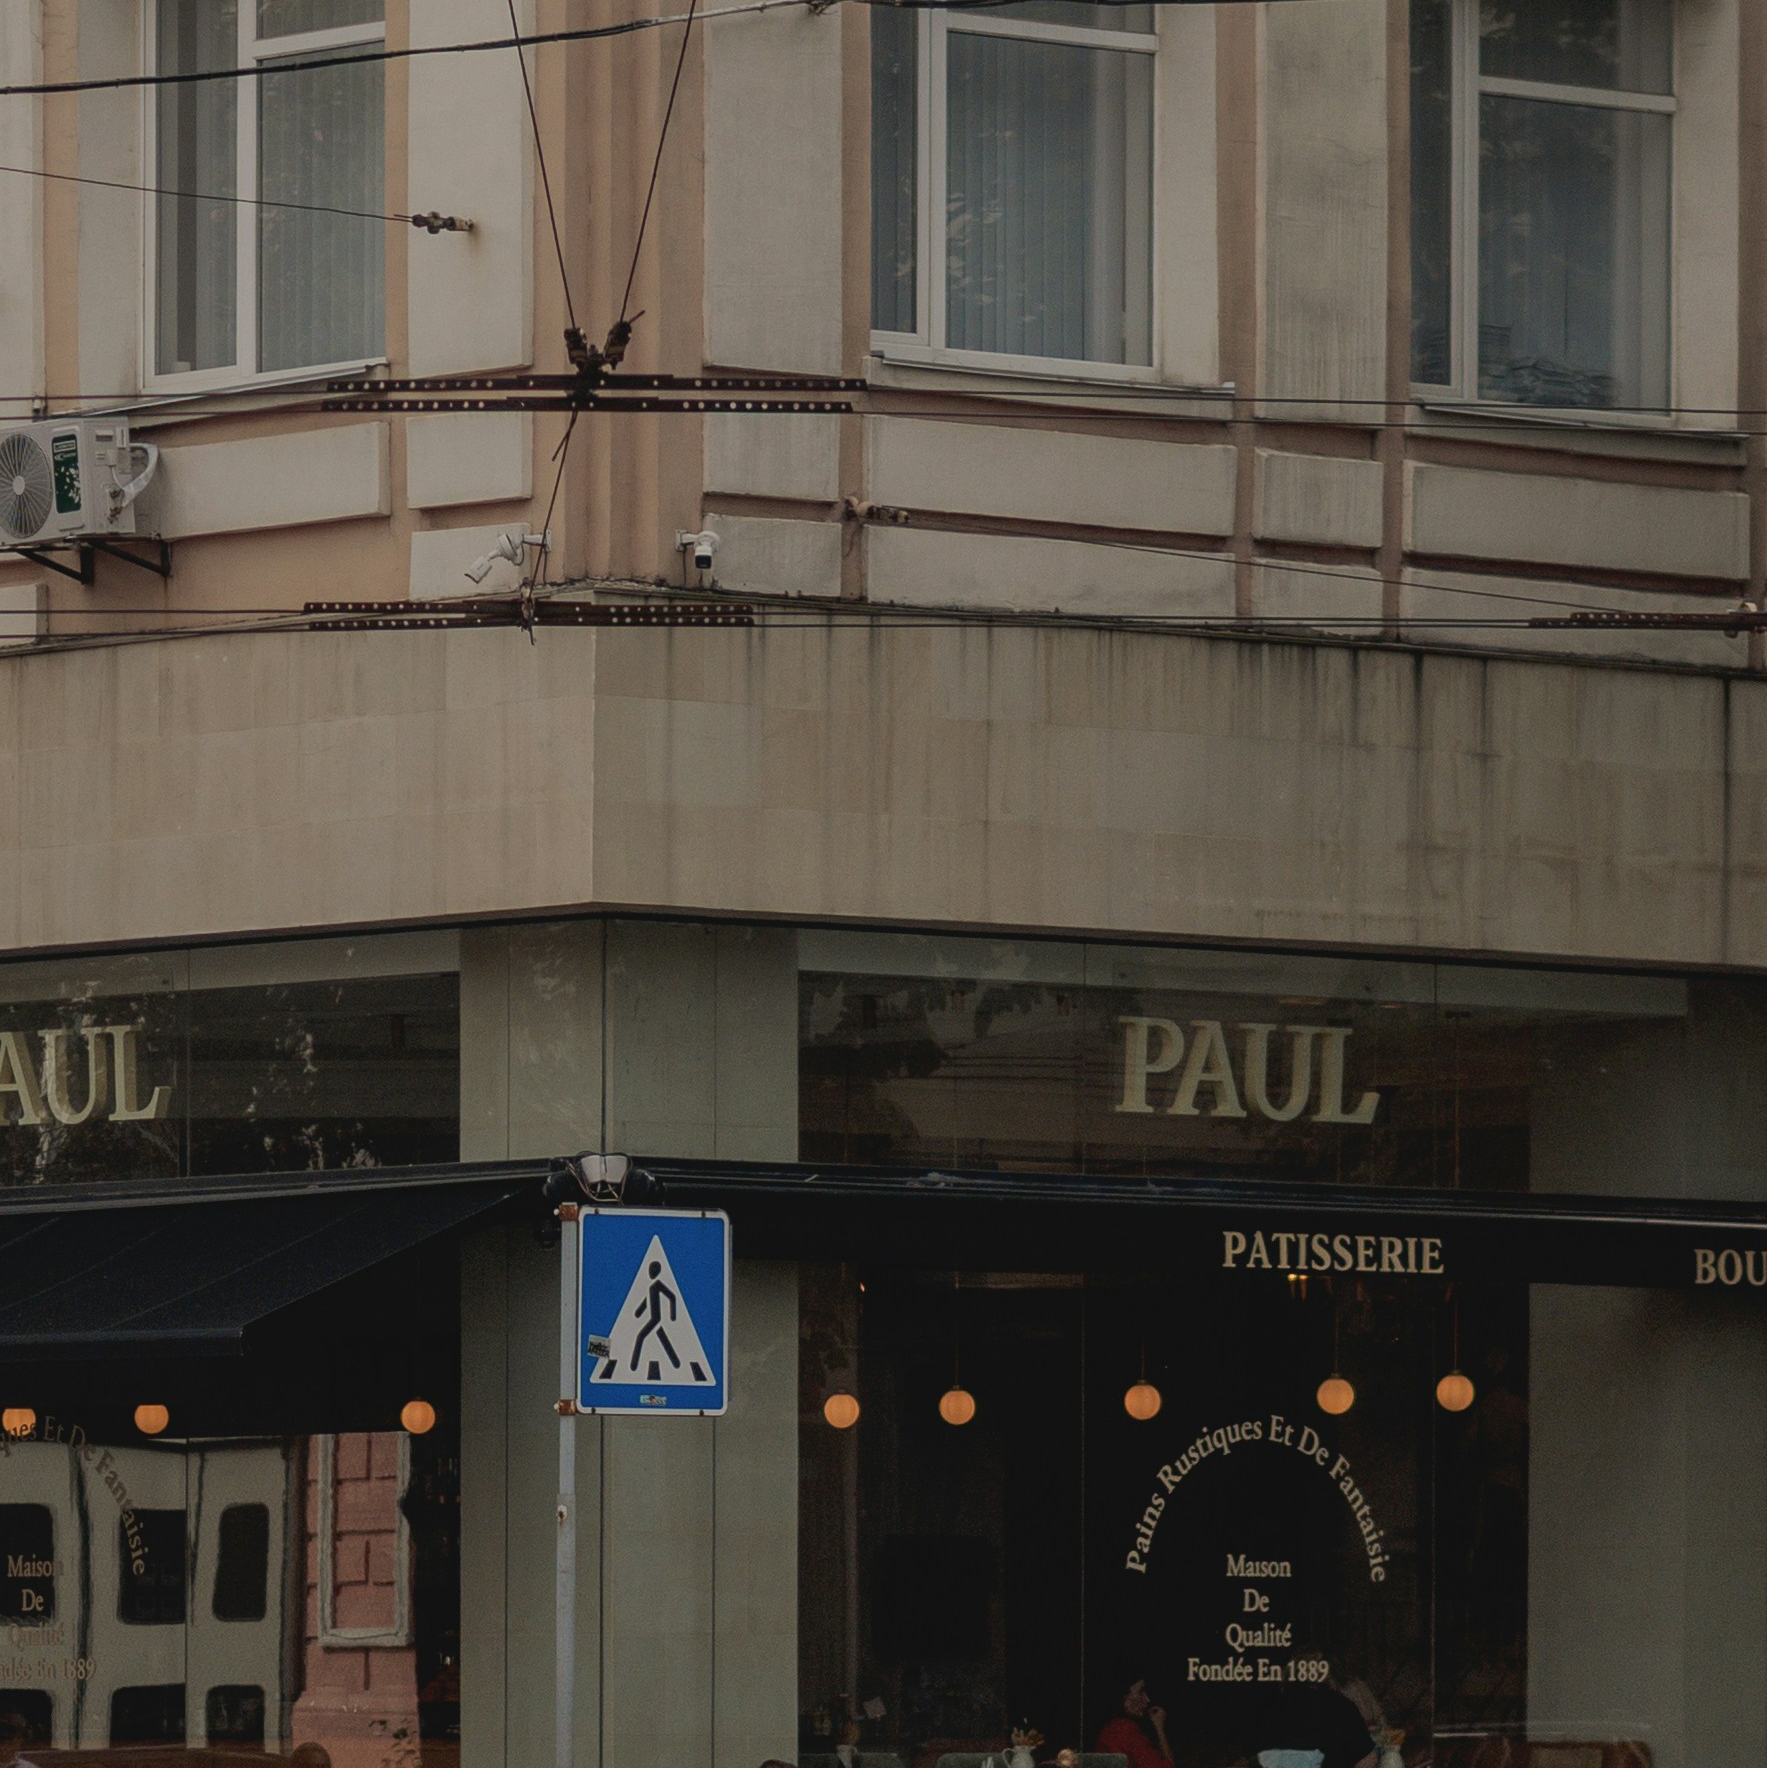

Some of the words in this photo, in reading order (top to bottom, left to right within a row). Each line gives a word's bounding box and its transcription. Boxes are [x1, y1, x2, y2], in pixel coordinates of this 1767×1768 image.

[1115, 1016, 1380, 1124] PAUL
[1222, 1230, 1445, 1274] PATISSERIE
[1693, 1248, 1767, 1286] BOU
[44, 1415, 64, 1443] Et
[95, 1450, 150, 1576] Fantaisie
[1125, 1492, 1166, 1574] Pains
[1156, 1419, 1263, 1494] Rustiques
[1268, 1414, 1295, 1447] Et
[1297, 1426, 1330, 1466] De
[1328, 1453, 1391, 1583] Fantaisie
[8, 1555, 64, 1578] Maison
[1226, 1553, 1292, 1578] Maison
[22, 1590, 44, 1611] De
[1243, 1588, 1270, 1612] De
[1225, 1623, 1293, 1653] Qualité
[63, 1658, 97, 1680] 1889
[1187, 1657, 1253, 1682] Fondée
[1257, 1659, 1283, 1682] En
[1287, 1660, 1330, 1682] 1889
